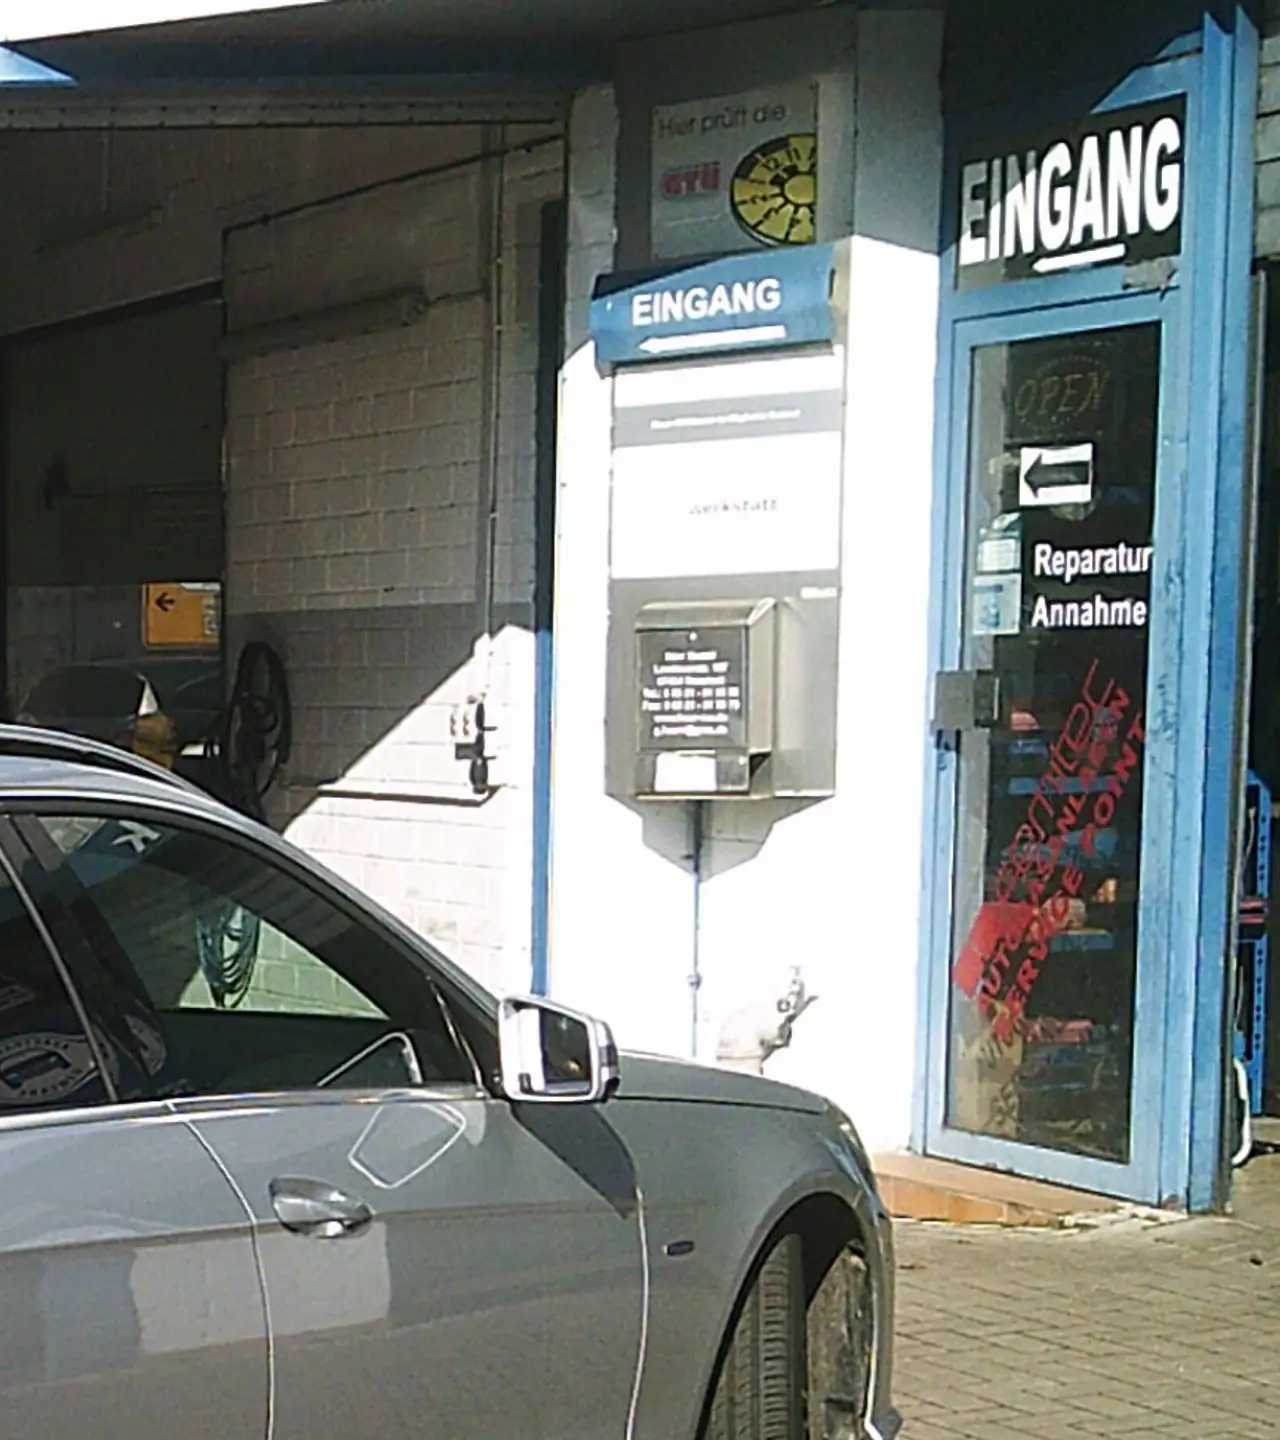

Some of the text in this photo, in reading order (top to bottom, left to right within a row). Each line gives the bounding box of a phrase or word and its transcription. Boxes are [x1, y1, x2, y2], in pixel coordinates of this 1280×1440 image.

[959, 116, 1182, 266] EINGANG
[632, 278, 781, 326] EINGANG
[1034, 542, 1154, 583] Reparatur
[1031, 594, 1147, 628] Annahme
